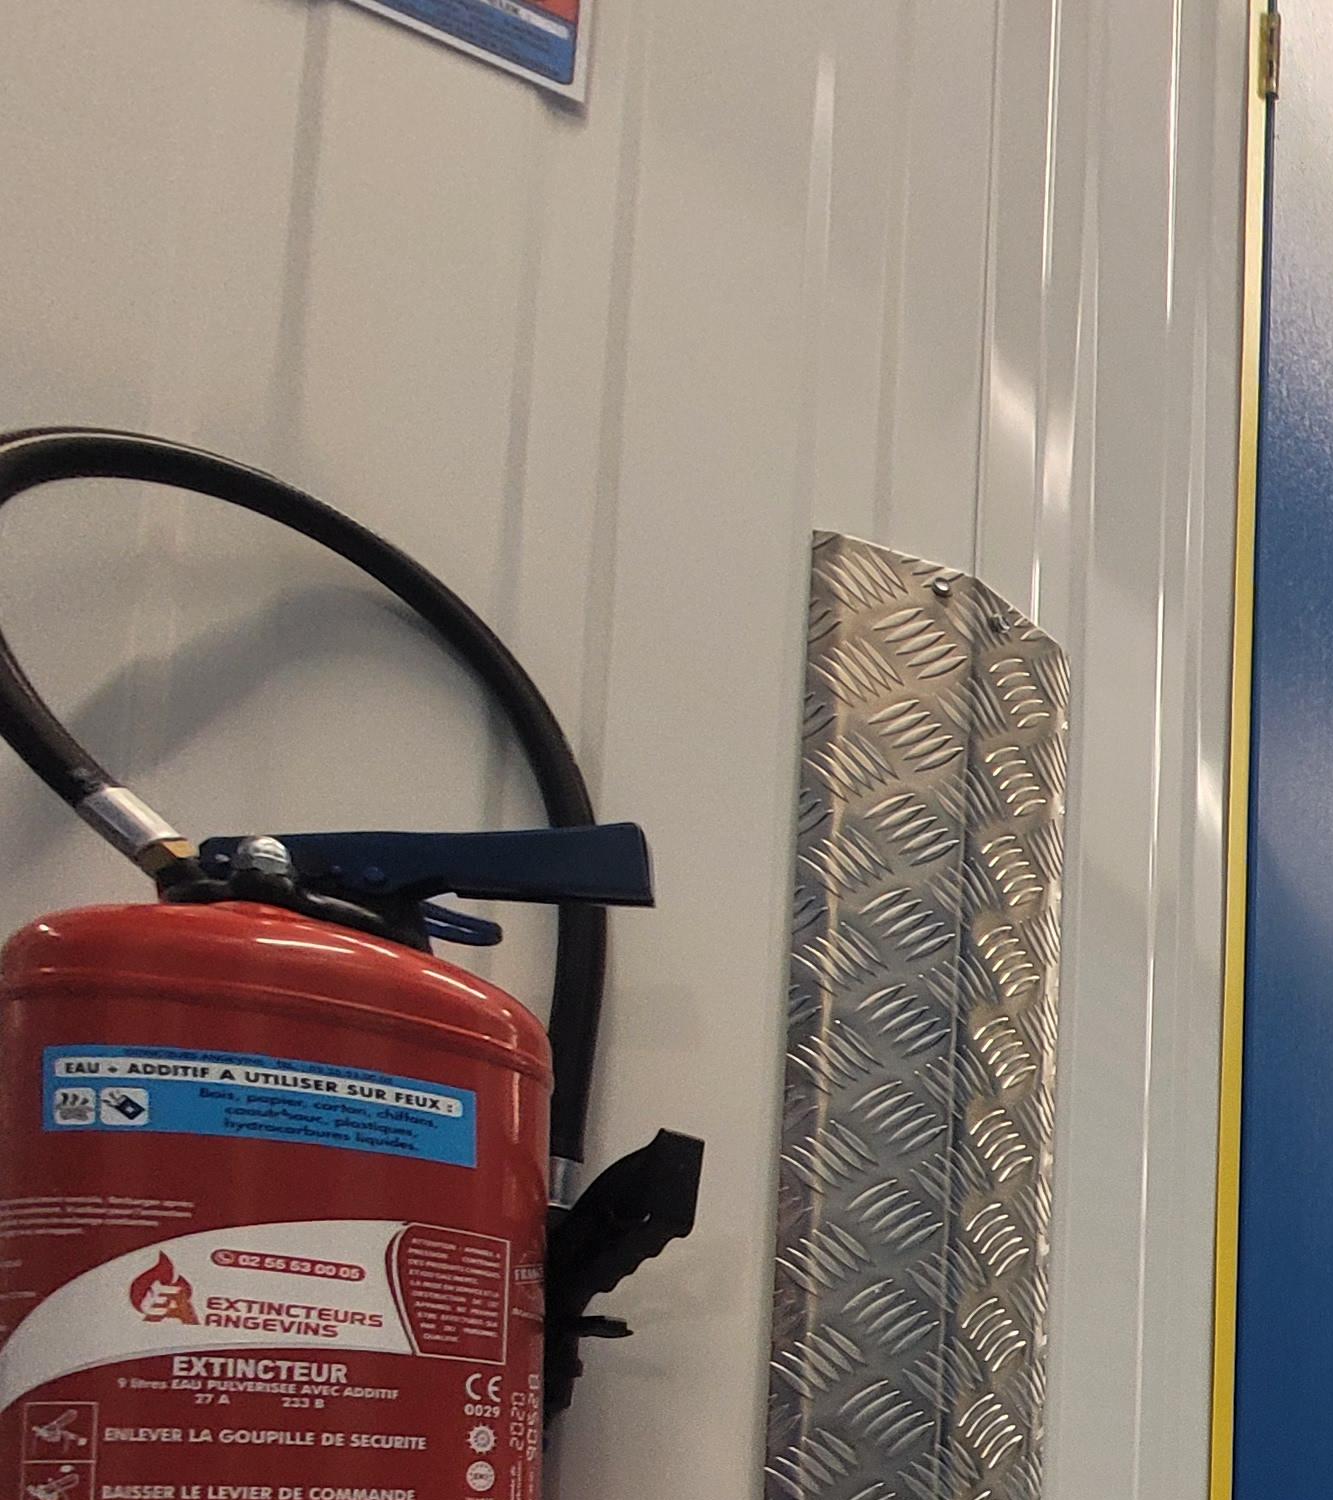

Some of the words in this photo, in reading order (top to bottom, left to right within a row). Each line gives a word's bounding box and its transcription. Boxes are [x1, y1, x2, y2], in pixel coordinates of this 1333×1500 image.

[65, 1061, 100, 1074] EAU
[127, 1063, 210, 1078] ADDITIF
[220, 1069, 236, 1081] A
[245, 1071, 339, 1093] UTILISER
[347, 1084, 387, 1101] SUR
[395, 1092, 441, 1110] FEUX
[238, 1254, 260, 1267] 02
[314, 1262, 336, 1276] 00
[206, 1297, 384, 1328] EXTINCTEURS
[204, 1313, 339, 1338] ANGEVINS
[172, 1355, 348, 1384] EXTINCTEUR
[171, 1379, 202, 1390] EAU
[206, 1380, 297, 1395] PULVERISEE
[301, 1384, 340, 1397] AVEC
[343, 1386, 399, 1400] ADDITIF
[217, 1394, 231, 1405] A
[463, 1403, 501, 1418] 0029
[104, 1427, 182, 1442] ENLEVER
[188, 1428, 213, 1443] LA
[218, 1429, 315, 1446] GOUPILLE
[321, 1432, 345, 1447] DE
[350, 1433, 427, 1450] SECURITE
[102, 1485, 175, 1500] BAISSER
[181, 1486, 201, 1500] LE
[207, 1486, 272, 1500] LEVIER
[278, 1487, 303, 1500] DE
